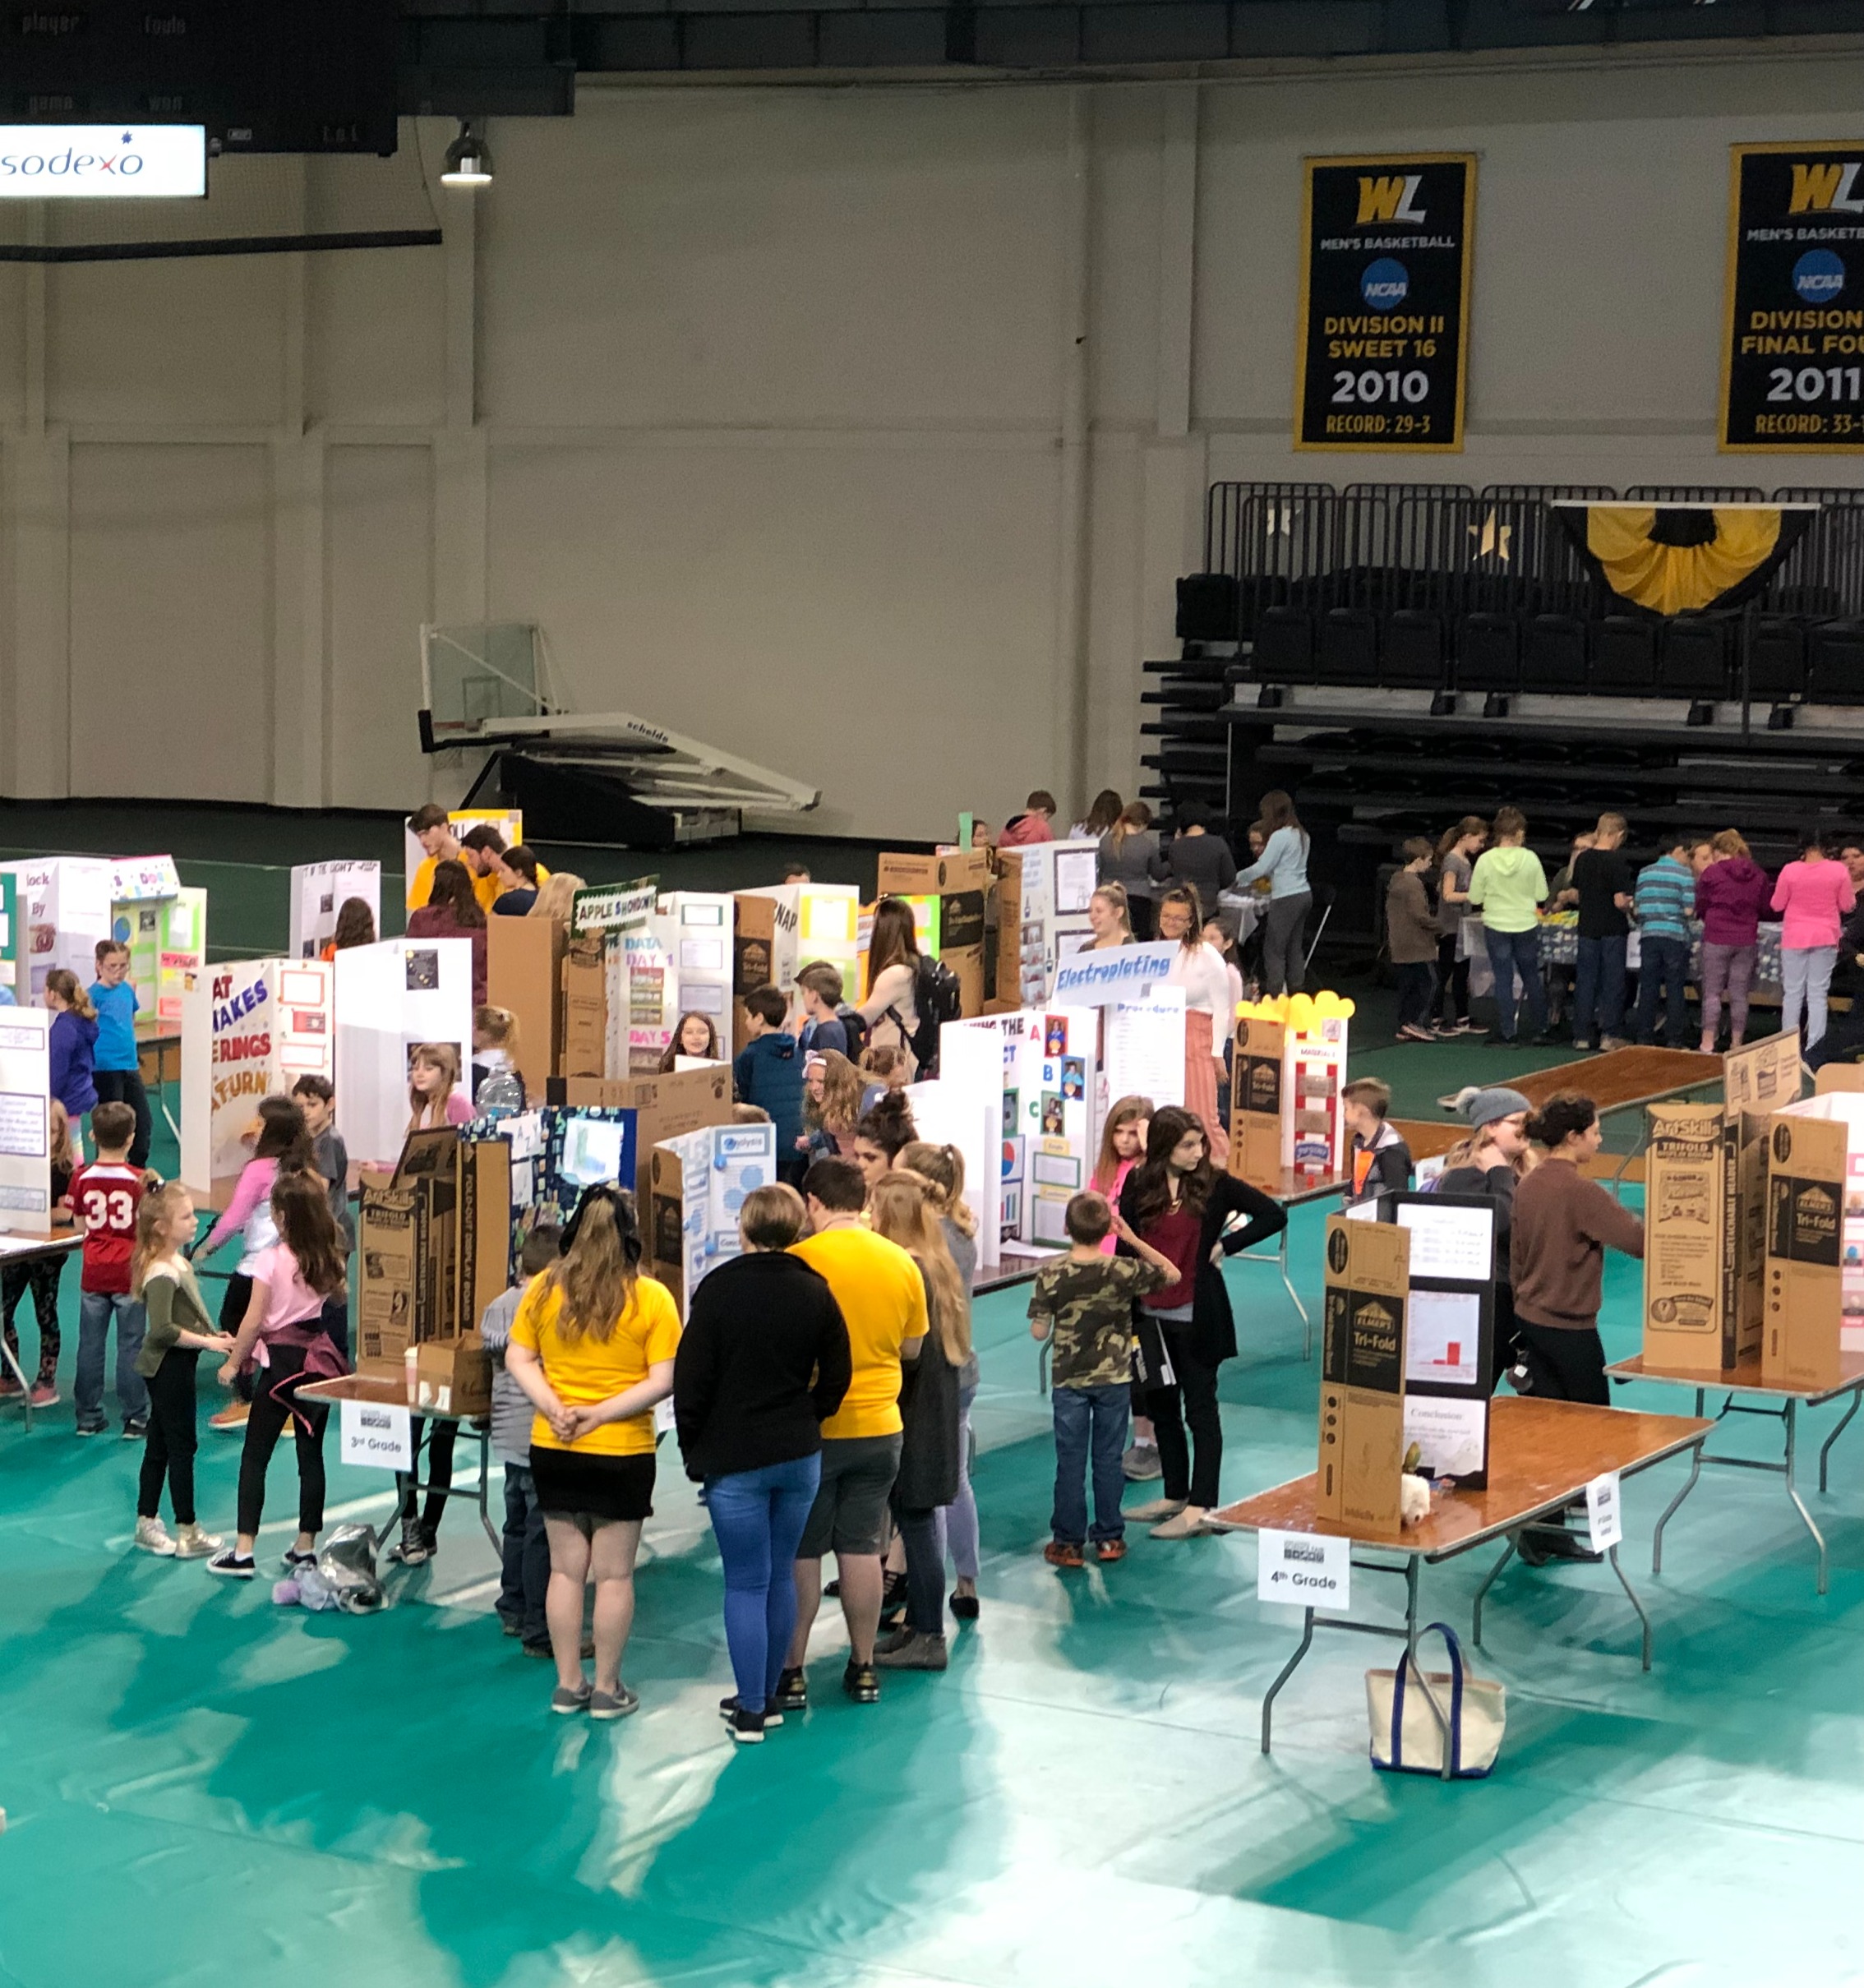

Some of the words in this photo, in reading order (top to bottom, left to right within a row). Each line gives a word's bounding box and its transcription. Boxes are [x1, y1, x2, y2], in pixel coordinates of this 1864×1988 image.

[1, 147, 144, 176] sodexo
[1789, 162, 1864, 215] WL
[1356, 174, 1428, 224] WL
[1320, 238, 1361, 250] MEN'S
[1364, 235, 1456, 249] BASKETBALL
[1747, 228, 1794, 241] MEN'S
[1365, 282, 1408, 298] NCAA
[1797, 274, 1843, 291] NCAA
[1324, 316, 1424, 334] DIVISION
[1429, 316, 1445, 334] II
[1751, 310, 1863, 330] DIVISION
[1328, 339, 1408, 358] SWEET
[1414, 339, 1437, 358] 16
[1741, 334, 1816, 354] FINAL
[1331, 370, 1429, 403] 2010
[1767, 367, 1862, 402] 2011
[1326, 415, 1391, 434] RECORD:
[1395, 415, 1431, 434] 29-3
[1756, 413, 1829, 434] RECORD:
[579, 901, 612, 921] APPLE
[773, 902, 798, 933] NAP
[625, 937, 662, 950] DATA
[626, 953, 657, 967] DAY
[1057, 955, 1171, 990] Electroplating
[1001, 1017, 1025, 1037] THE
[1030, 1025, 1040, 1041] A
[219, 1032, 271, 1063] RINGS
[630, 1031, 657, 1045] DAY
[1043, 1064, 1054, 1082] B
[1029, 1101, 1040, 1119] C
[1653, 1119, 1720, 1139] ArtSkills
[1662, 1142, 1709, 1151] TRIFOLD
[1727, 1159, 1737, 1195] HEADER
[363, 1188, 415, 1207] ArtSkills
[464, 1174, 473, 1229] FOLD-OUT
[83, 1189, 133, 1229] 33
[1727, 1197, 1737, 1252] DETACHABLE
[464, 1233, 473, 1278] DISPLAY
[463, 1280, 471, 1321] BOARD
[1357, 1316, 1392, 1331] ELMER'S
[1354, 1331, 1396, 1351] Tri-Fold
[1410, 1407, 1463, 1421] Conclusion
[351, 1436, 365, 1448] 3rd
[367, 1437, 402, 1453] Grade
[1271, 1570, 1288, 1584] 4th
[1291, 1572, 1337, 1590] Grade
